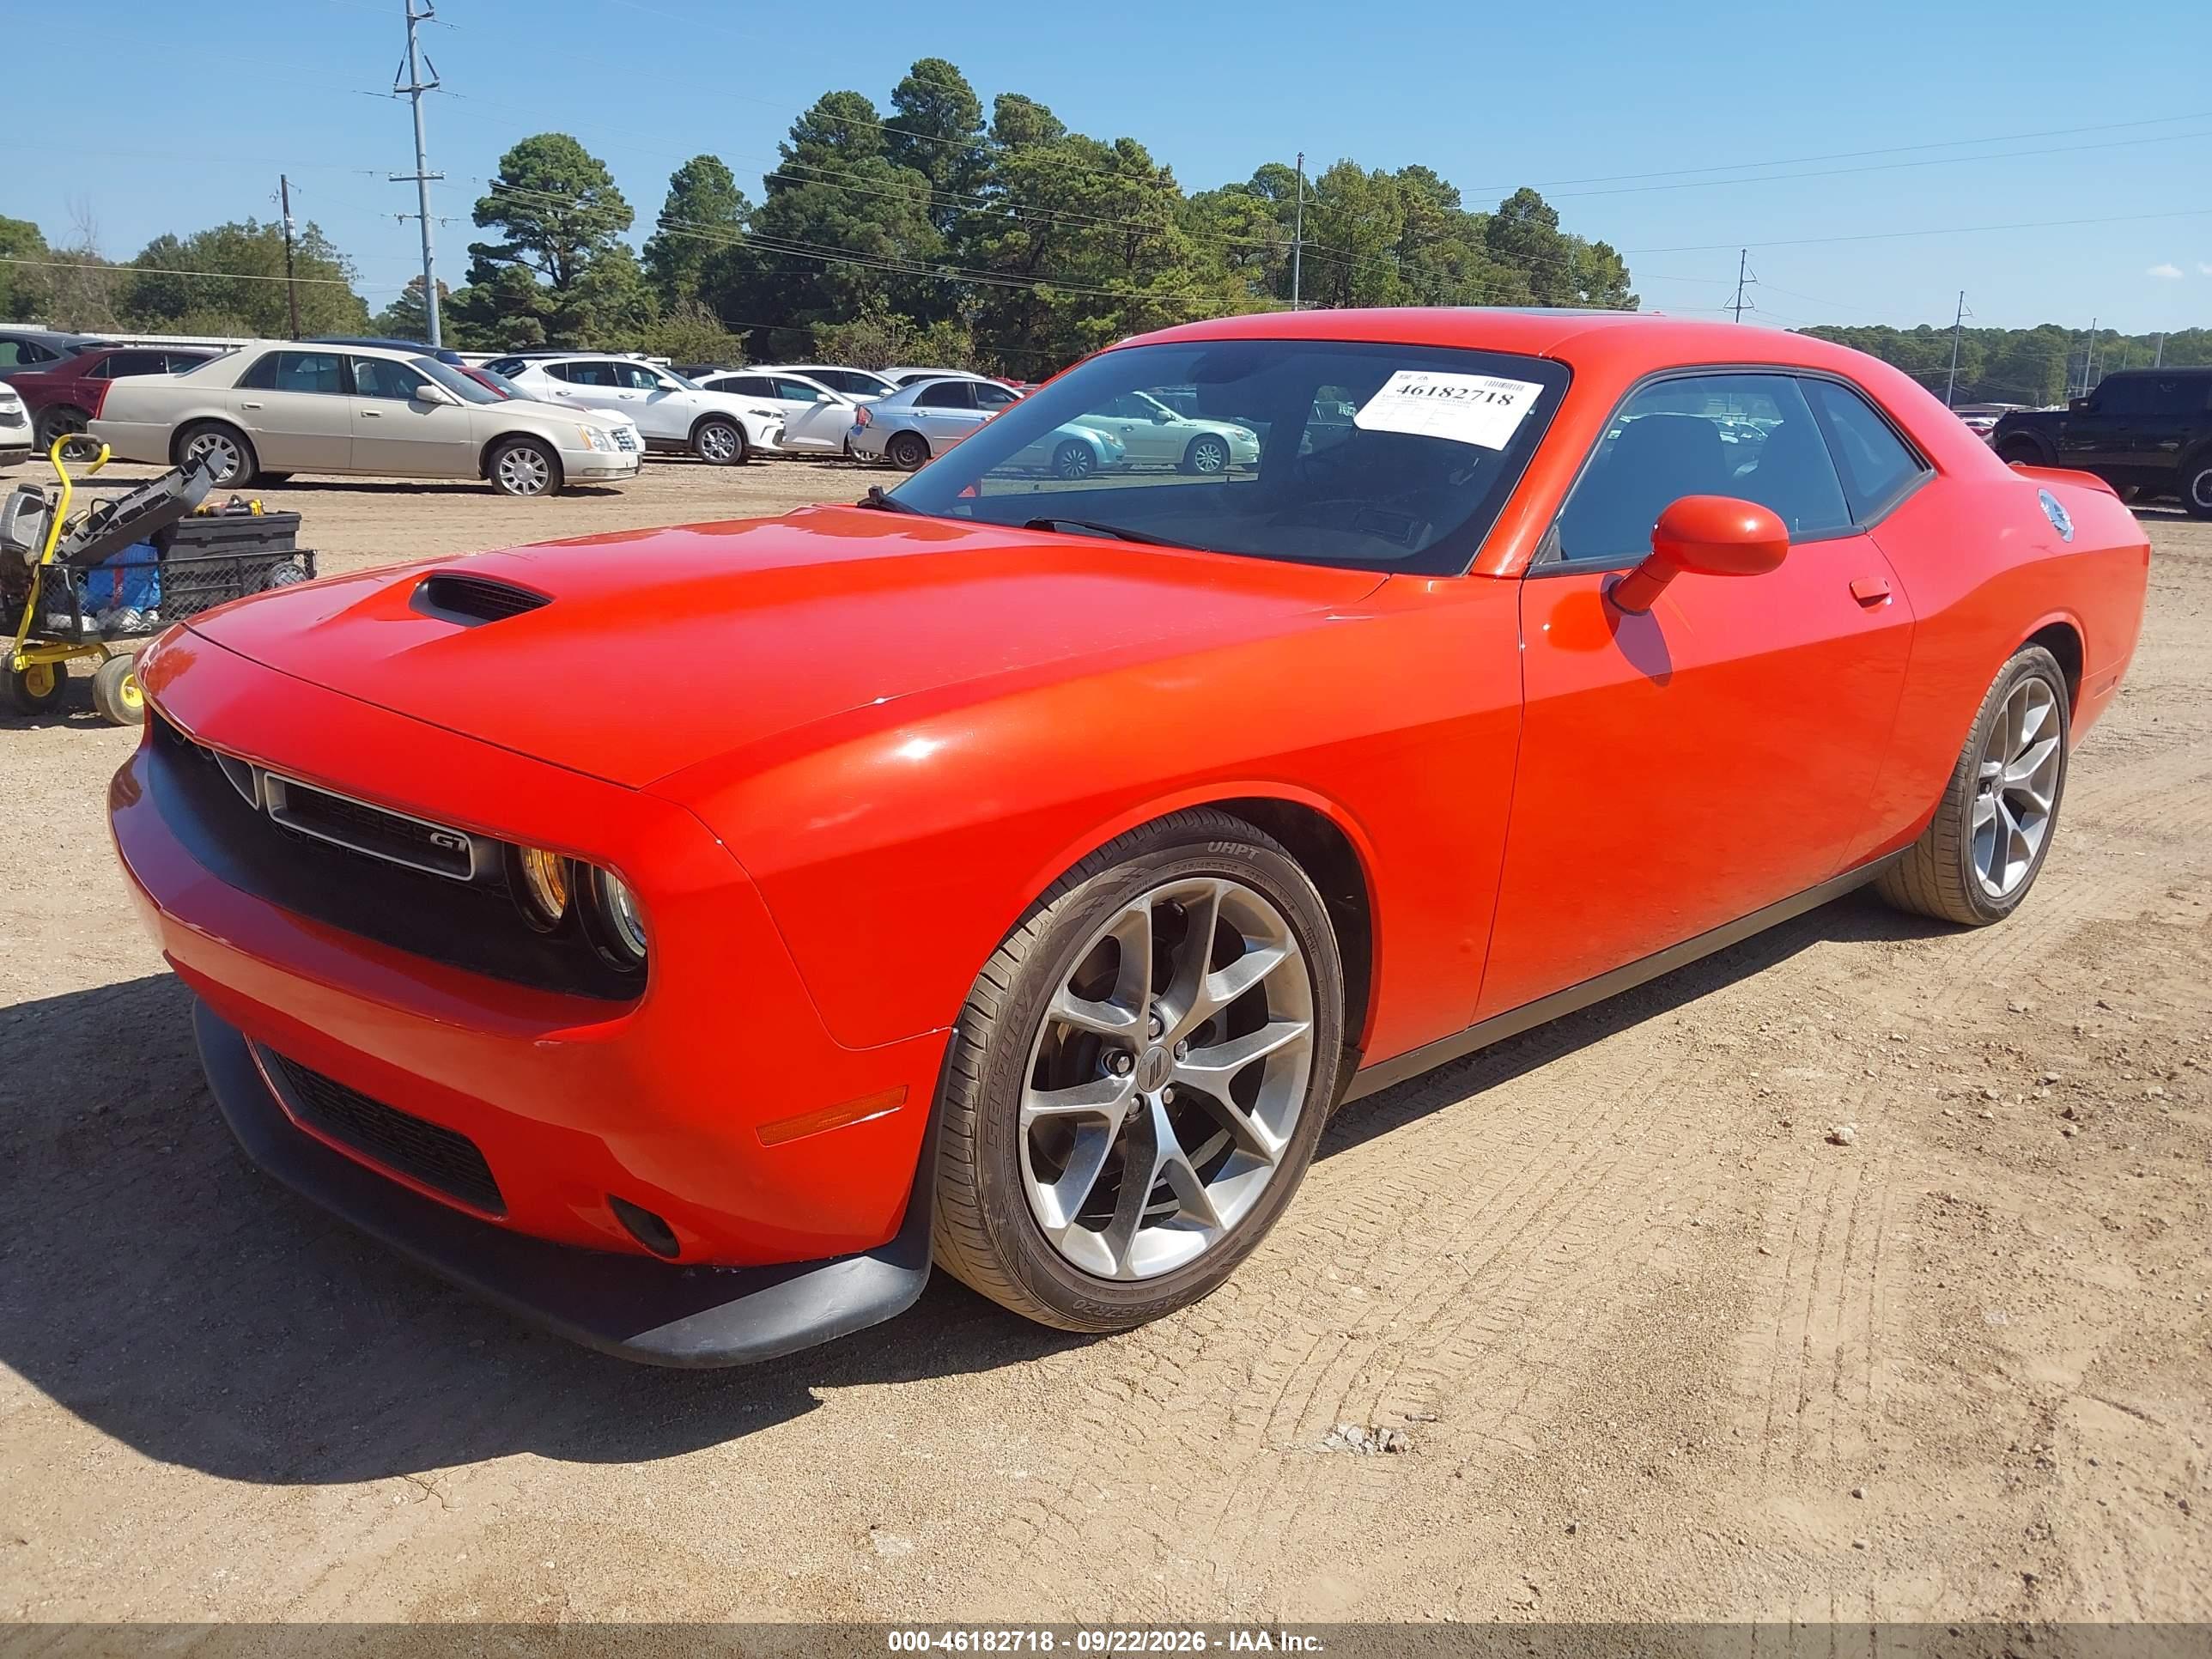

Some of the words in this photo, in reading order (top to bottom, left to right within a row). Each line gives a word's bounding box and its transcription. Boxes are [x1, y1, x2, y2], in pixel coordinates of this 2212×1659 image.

[1396, 384, 1515, 406] 46182718
[430, 832, 467, 852] GT
[1207, 841, 1261, 860] UHPT
